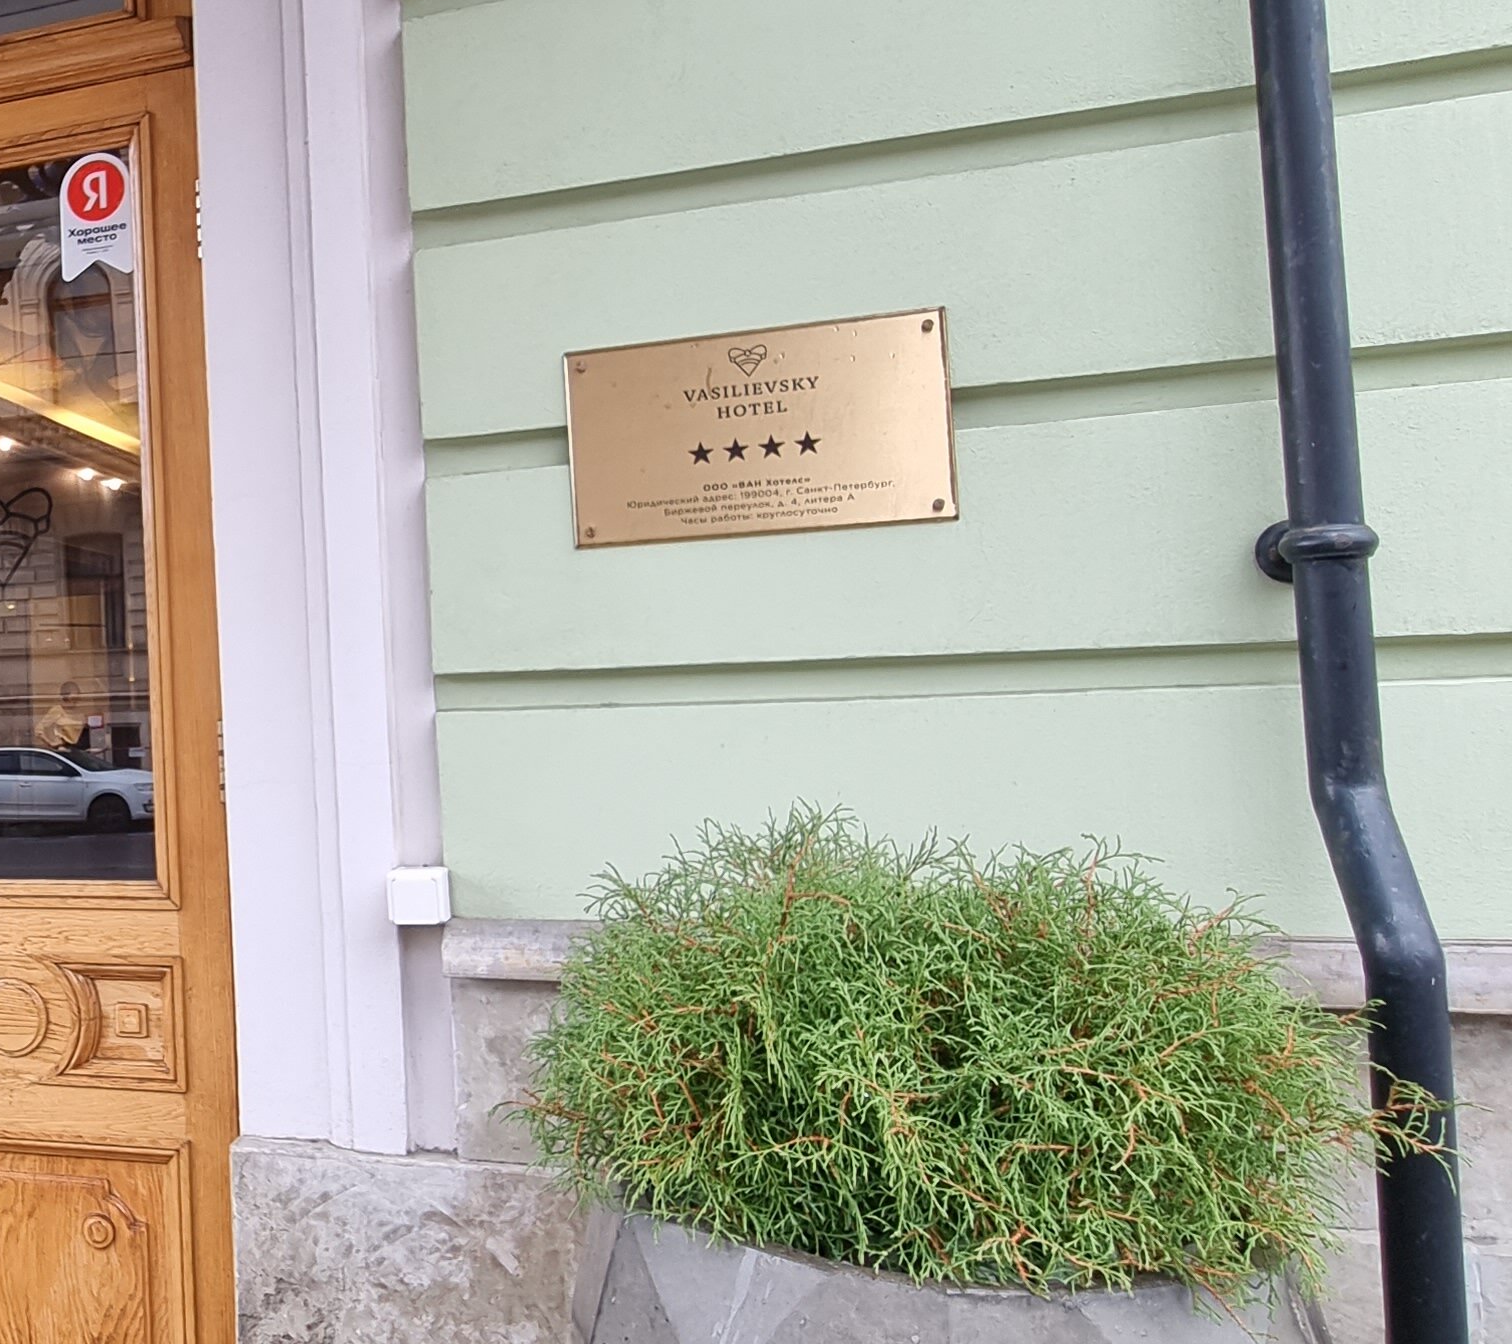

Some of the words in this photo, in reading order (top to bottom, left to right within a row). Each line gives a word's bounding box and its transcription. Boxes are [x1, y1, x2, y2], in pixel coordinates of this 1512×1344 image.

[82, 170, 108, 212] Я
[68, 222, 127, 238] Хорошее
[77, 233, 118, 245] место
[683, 376, 819, 402] VASILIEVSKY
[717, 400, 787, 419] HOTEL
[703, 482, 728, 492] ООО
[627, 495, 699, 509] Юридический
[702, 493, 737, 504] адрес:
[664, 504, 718, 517] Биржевой
[804, 494, 843, 506] литера
[680, 516, 707, 525] Часы
[710, 513, 753, 525] работы:
[757, 506, 839, 520] круглосуточно
